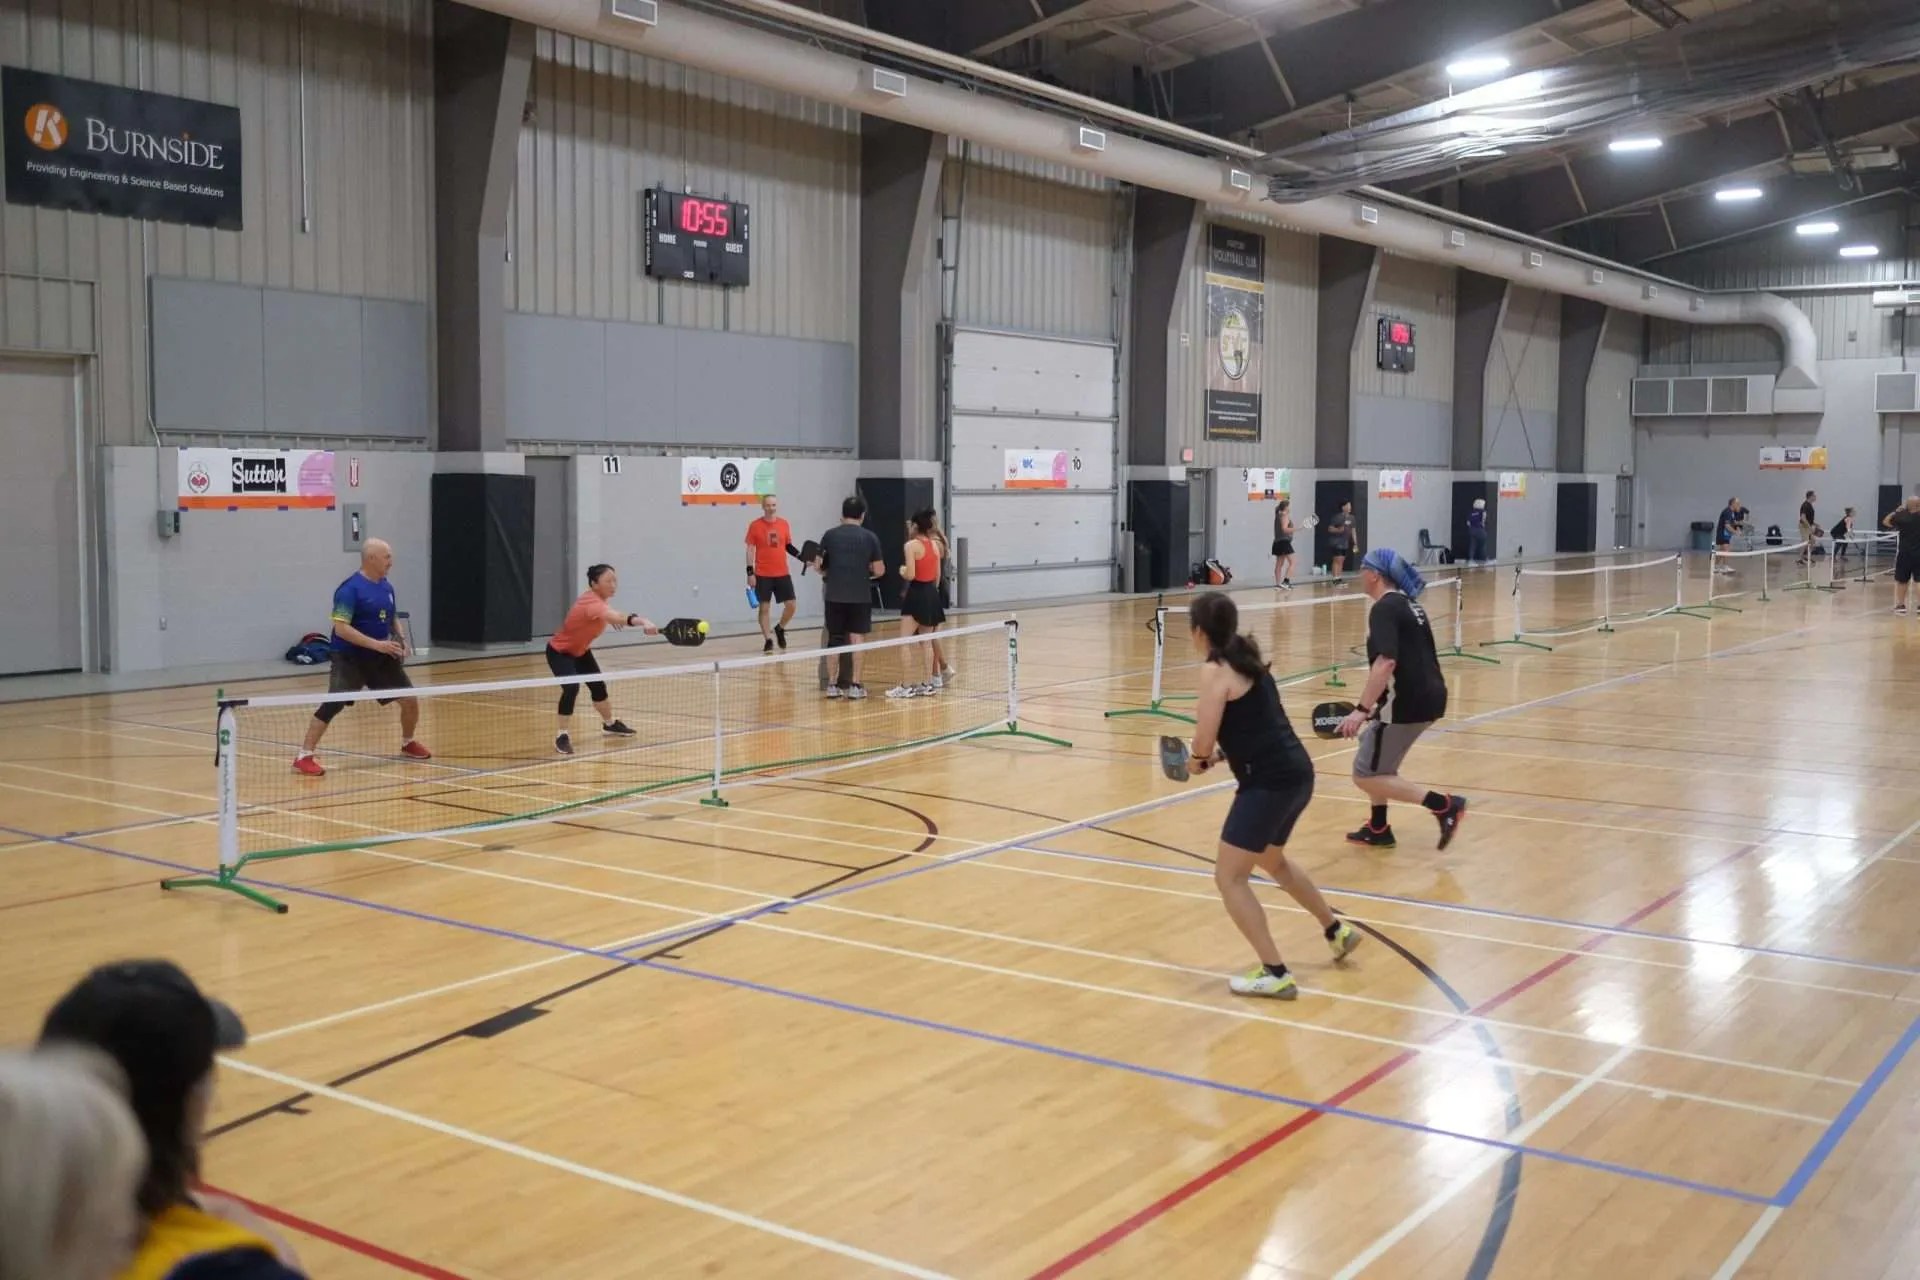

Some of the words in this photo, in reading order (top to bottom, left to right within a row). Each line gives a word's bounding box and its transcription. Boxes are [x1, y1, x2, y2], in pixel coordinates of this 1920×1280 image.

[86, 117, 225, 170] BURNSIDE
[26, 161, 67, 178] Providing
[69, 167, 120, 184] Engineering
[121, 174, 128, 184] &
[130, 176, 161, 189] Science
[163, 181, 188, 192] Based
[189, 184, 224, 198] Solutions
[682, 200, 728, 236] 10:55
[232, 461, 286, 484] Sutton
[604, 457, 619, 473] 11
[1073, 458, 1081, 470] 10
[1243, 470, 1248, 481] 9
